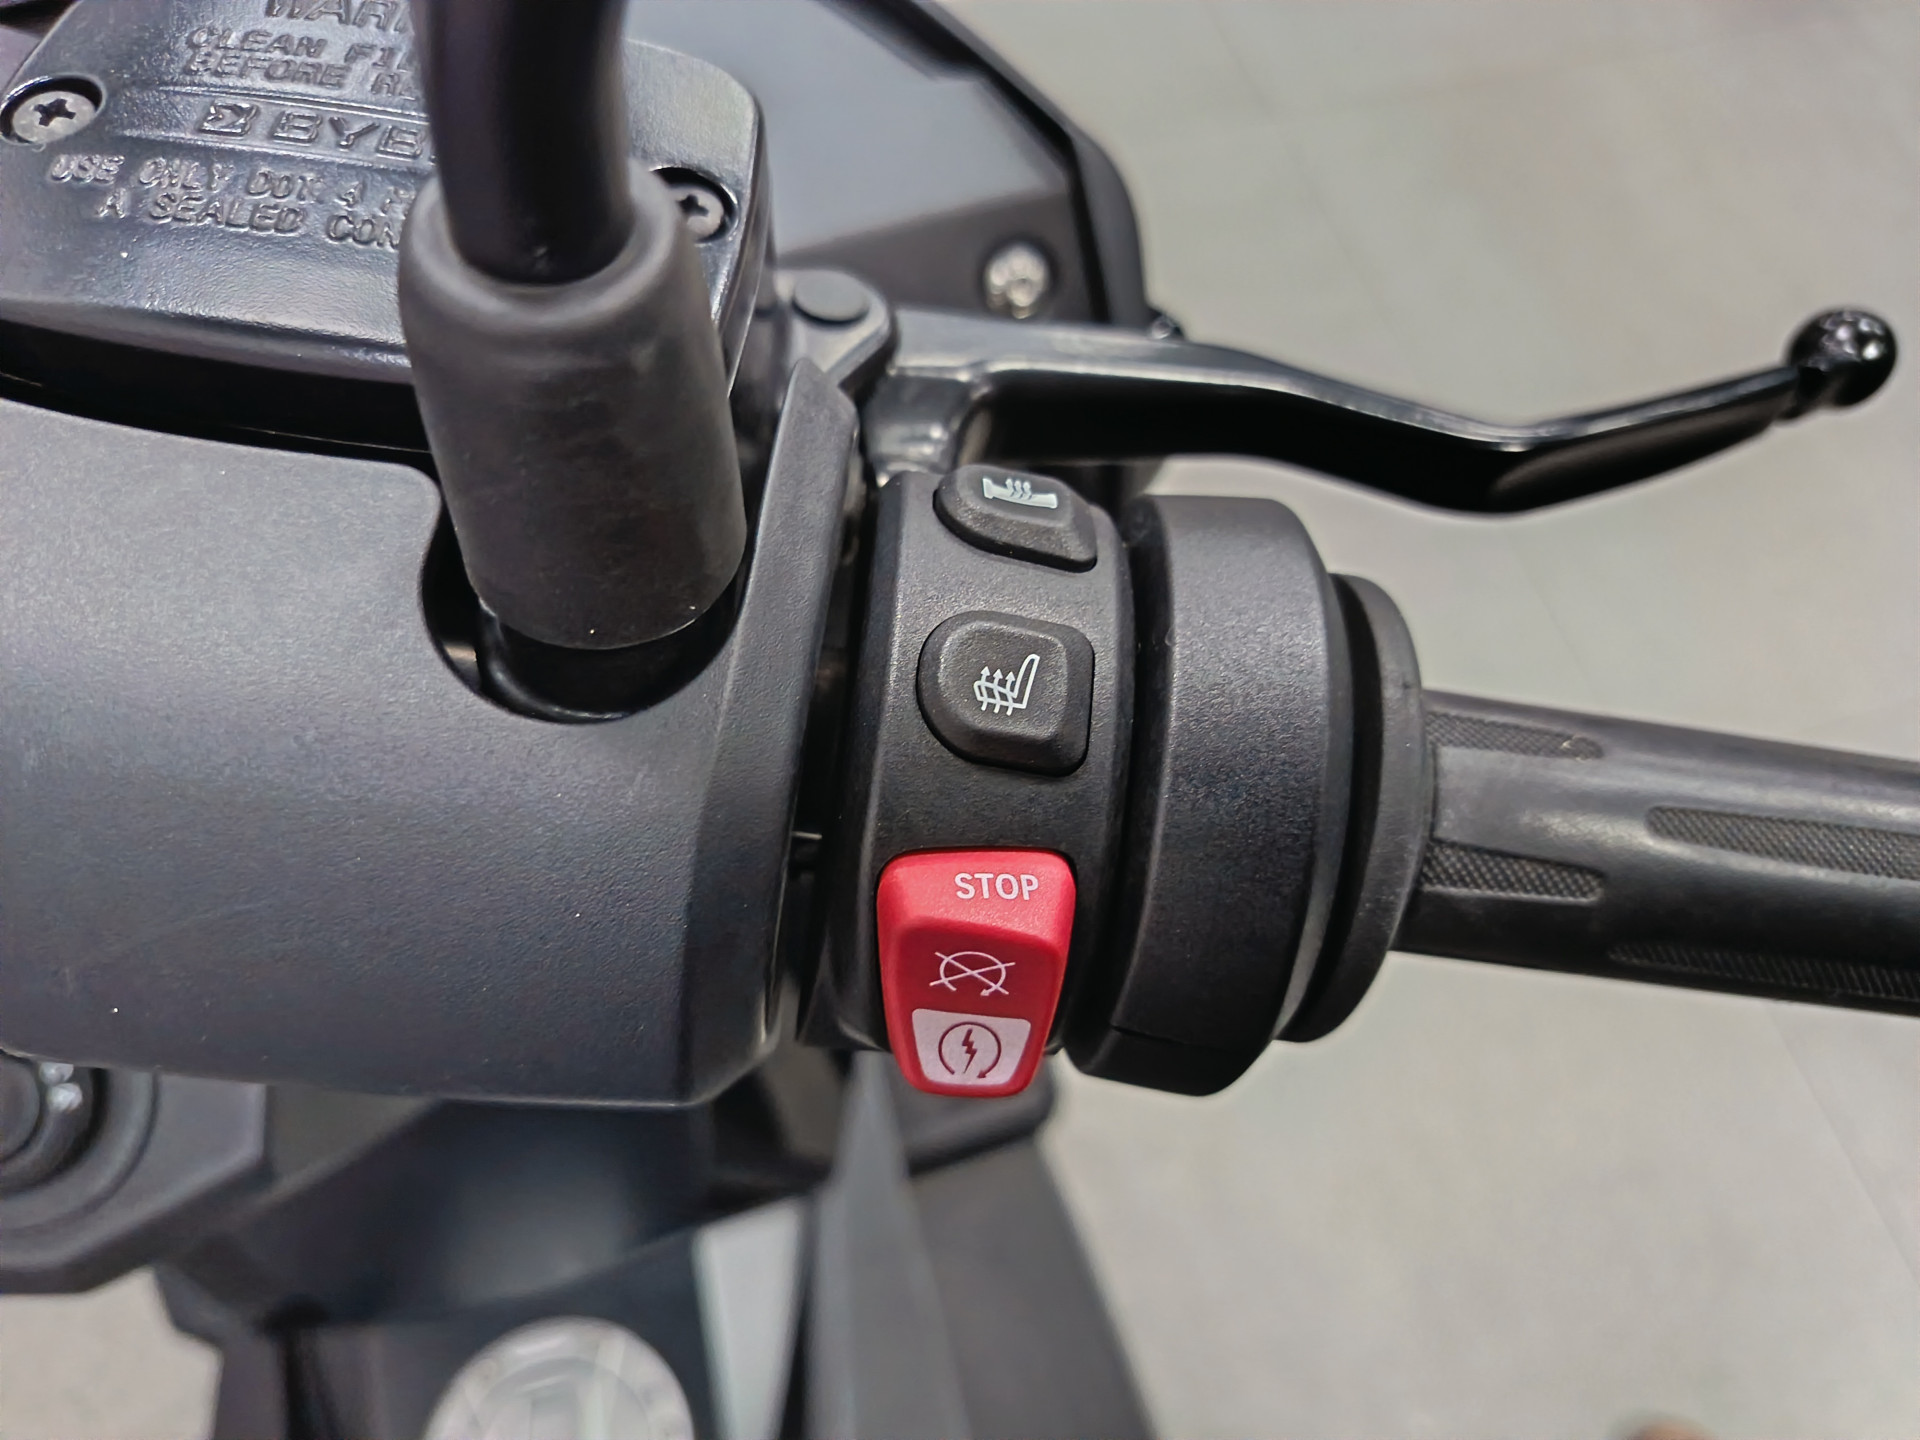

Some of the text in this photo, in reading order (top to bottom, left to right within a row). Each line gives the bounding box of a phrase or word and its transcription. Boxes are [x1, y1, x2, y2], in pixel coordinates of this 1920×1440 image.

[186, 27, 328, 58] CLEAN
[184, 50, 351, 88] BEFORE
[272, 108, 437, 165] BYB
[51, 154, 126, 184] USE
[138, 156, 236, 193] ONLY
[97, 187, 126, 219] A
[149, 192, 307, 236] SEALED
[954, 872, 1039, 901] STOP
